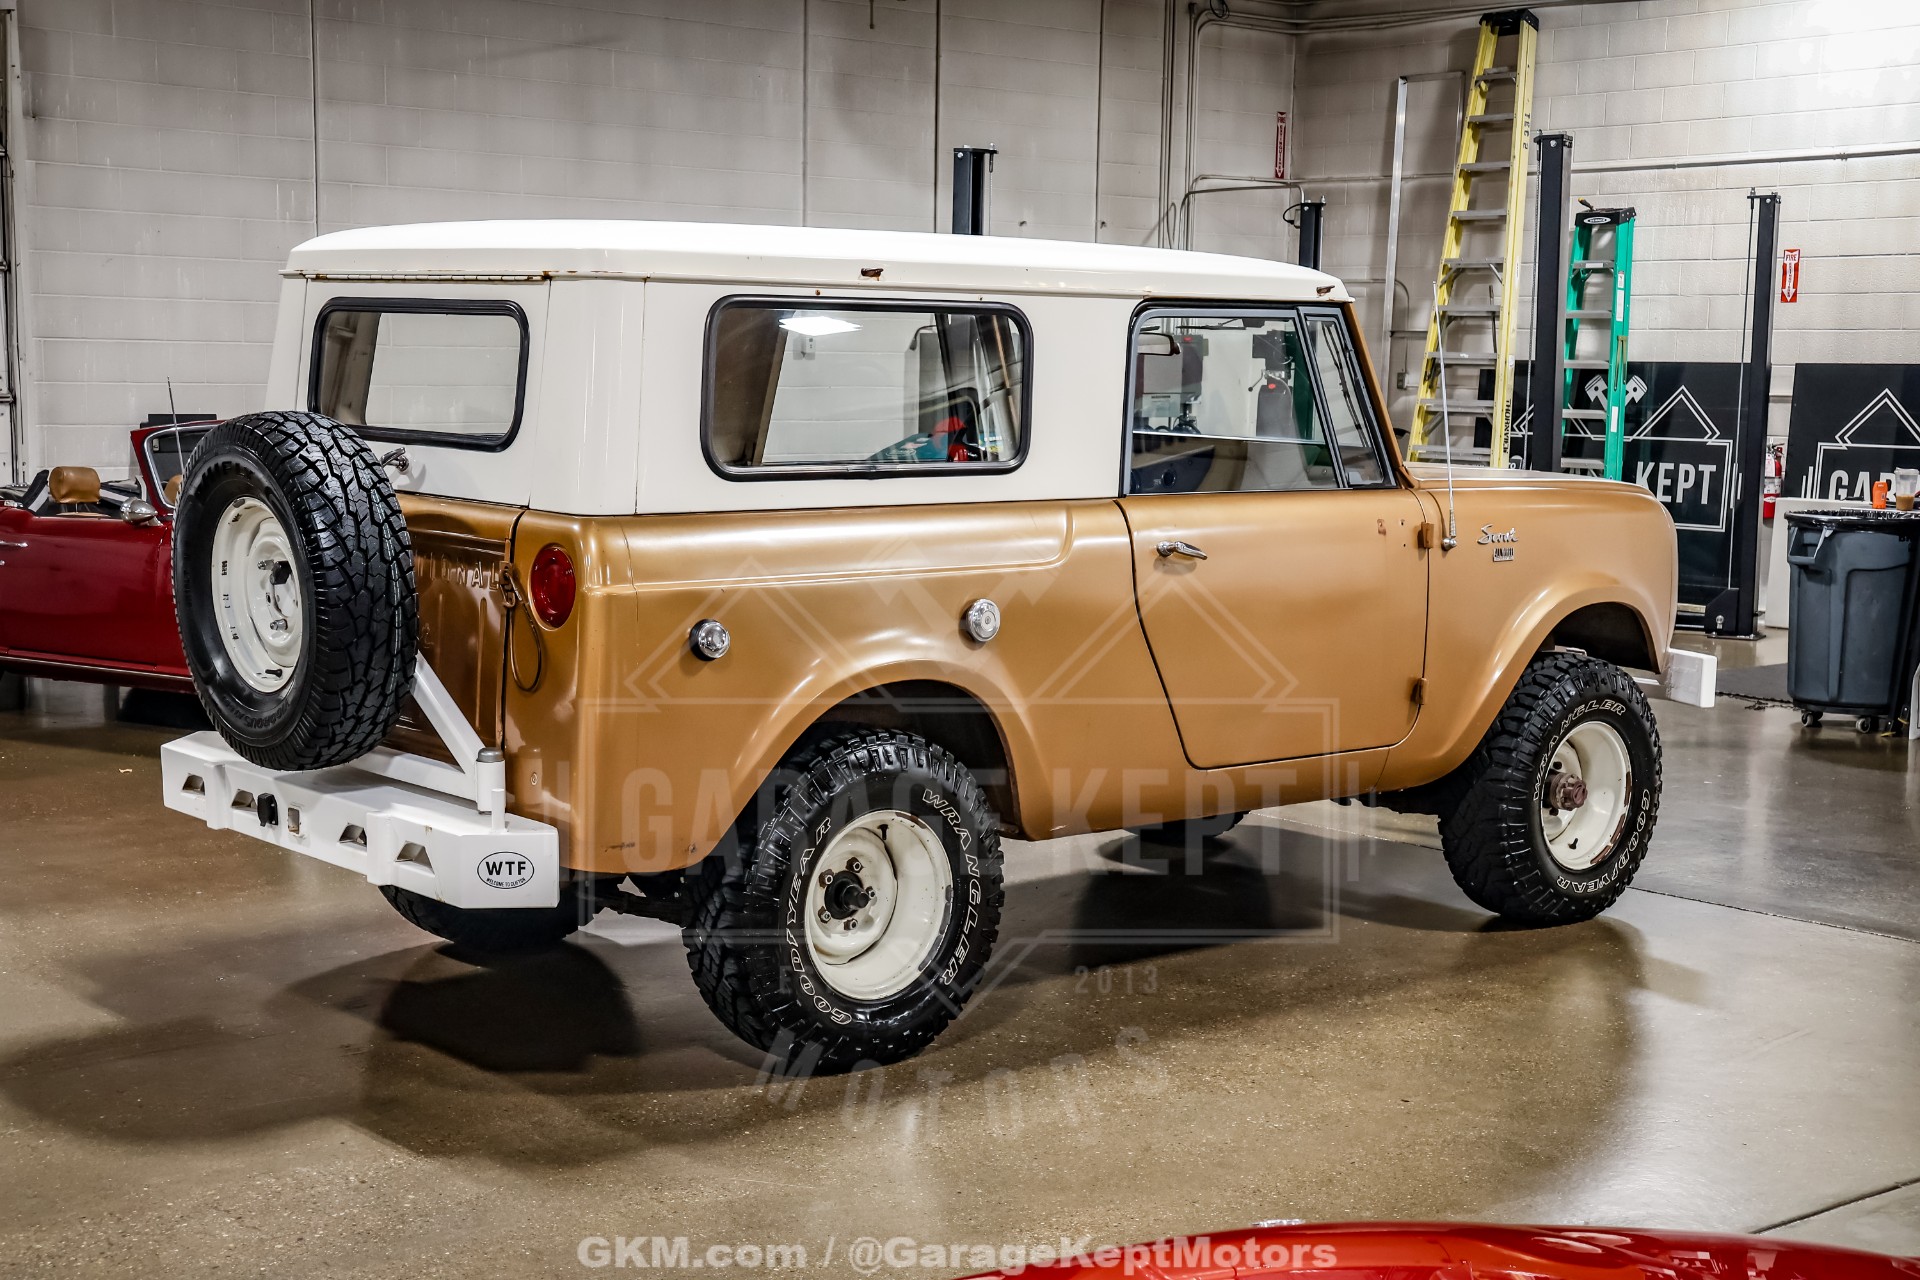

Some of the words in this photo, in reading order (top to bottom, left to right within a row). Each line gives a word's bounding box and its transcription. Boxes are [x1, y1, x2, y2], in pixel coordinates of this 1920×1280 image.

[1785, 253, 1797, 262] FIRE
[1635, 461, 1717, 505] KEPT
[1828, 469, 1920, 502] GAR
[1533, 699, 1627, 801] WRANGLER
[485, 861, 527, 876] WTF
[1556, 788, 1651, 893] GOODYEAR
[786, 816, 852, 1025] GOODYEAR
[922, 788, 981, 986] WRANGLER
